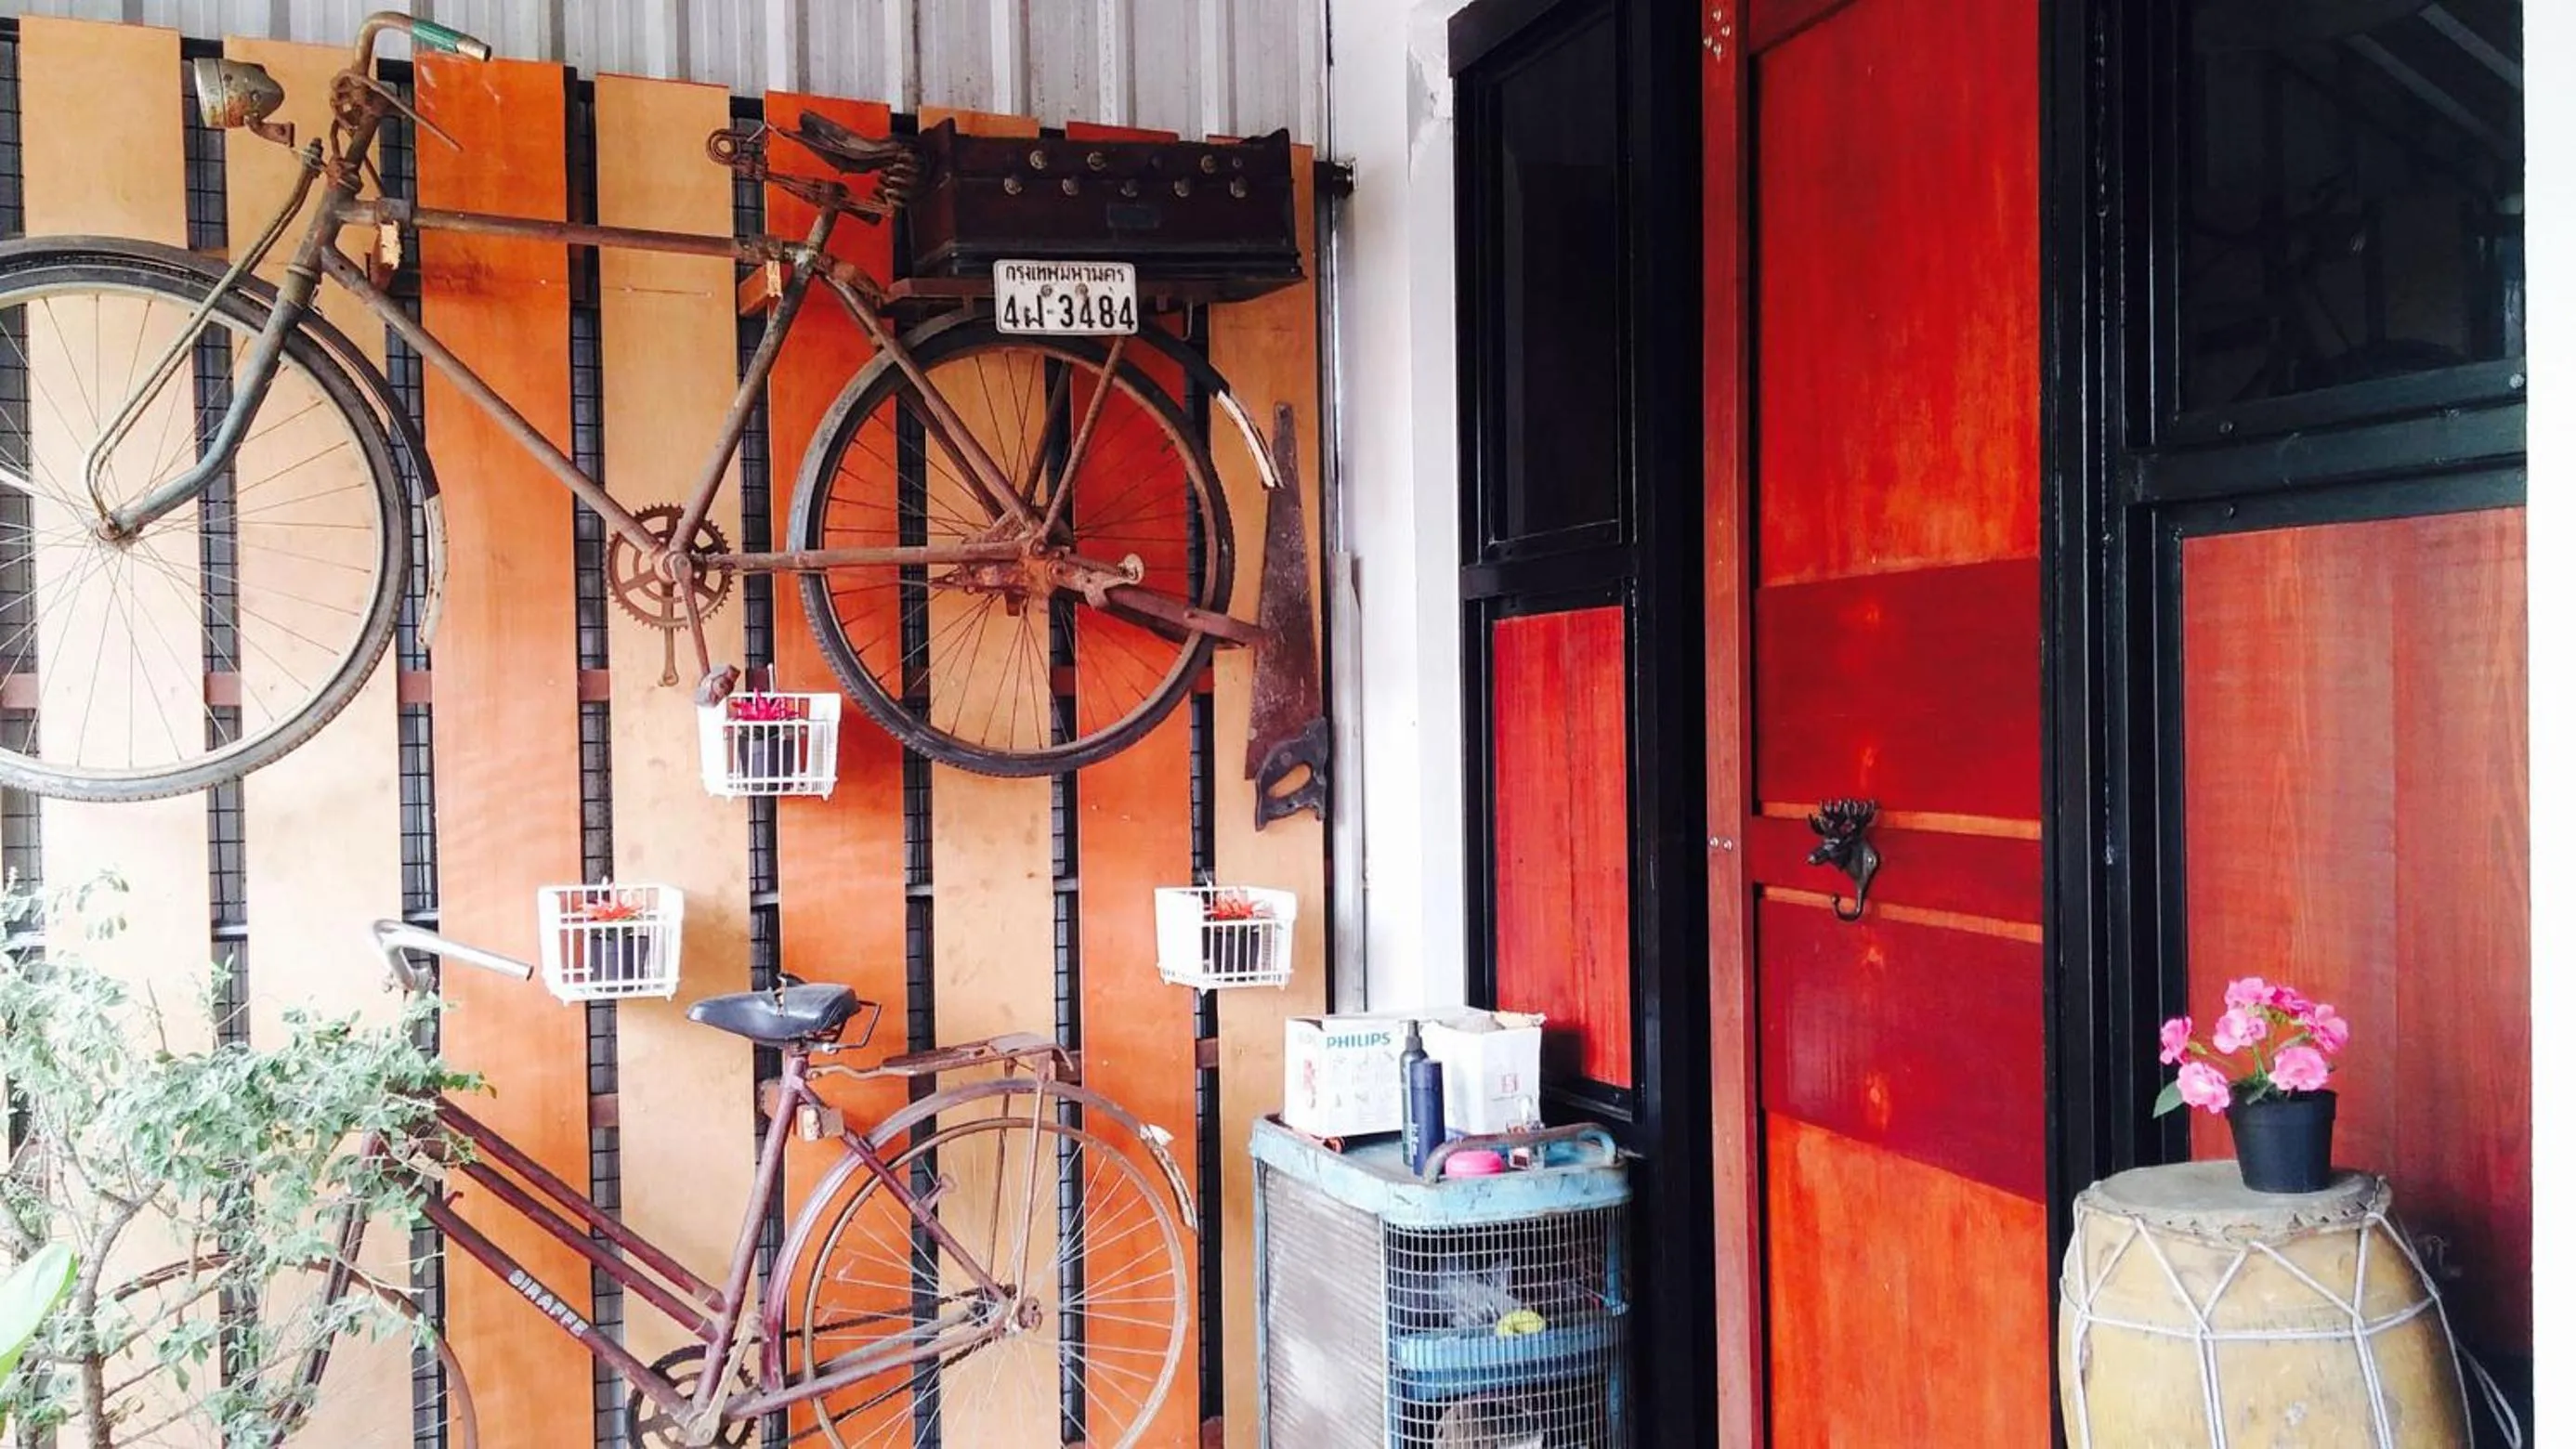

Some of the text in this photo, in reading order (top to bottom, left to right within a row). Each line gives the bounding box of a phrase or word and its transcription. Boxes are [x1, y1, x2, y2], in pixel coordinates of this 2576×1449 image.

[1006, 266, 1125, 284] กรุงเทพมหานคร
[1327, 1032, 1392, 1049] PHILIPS
